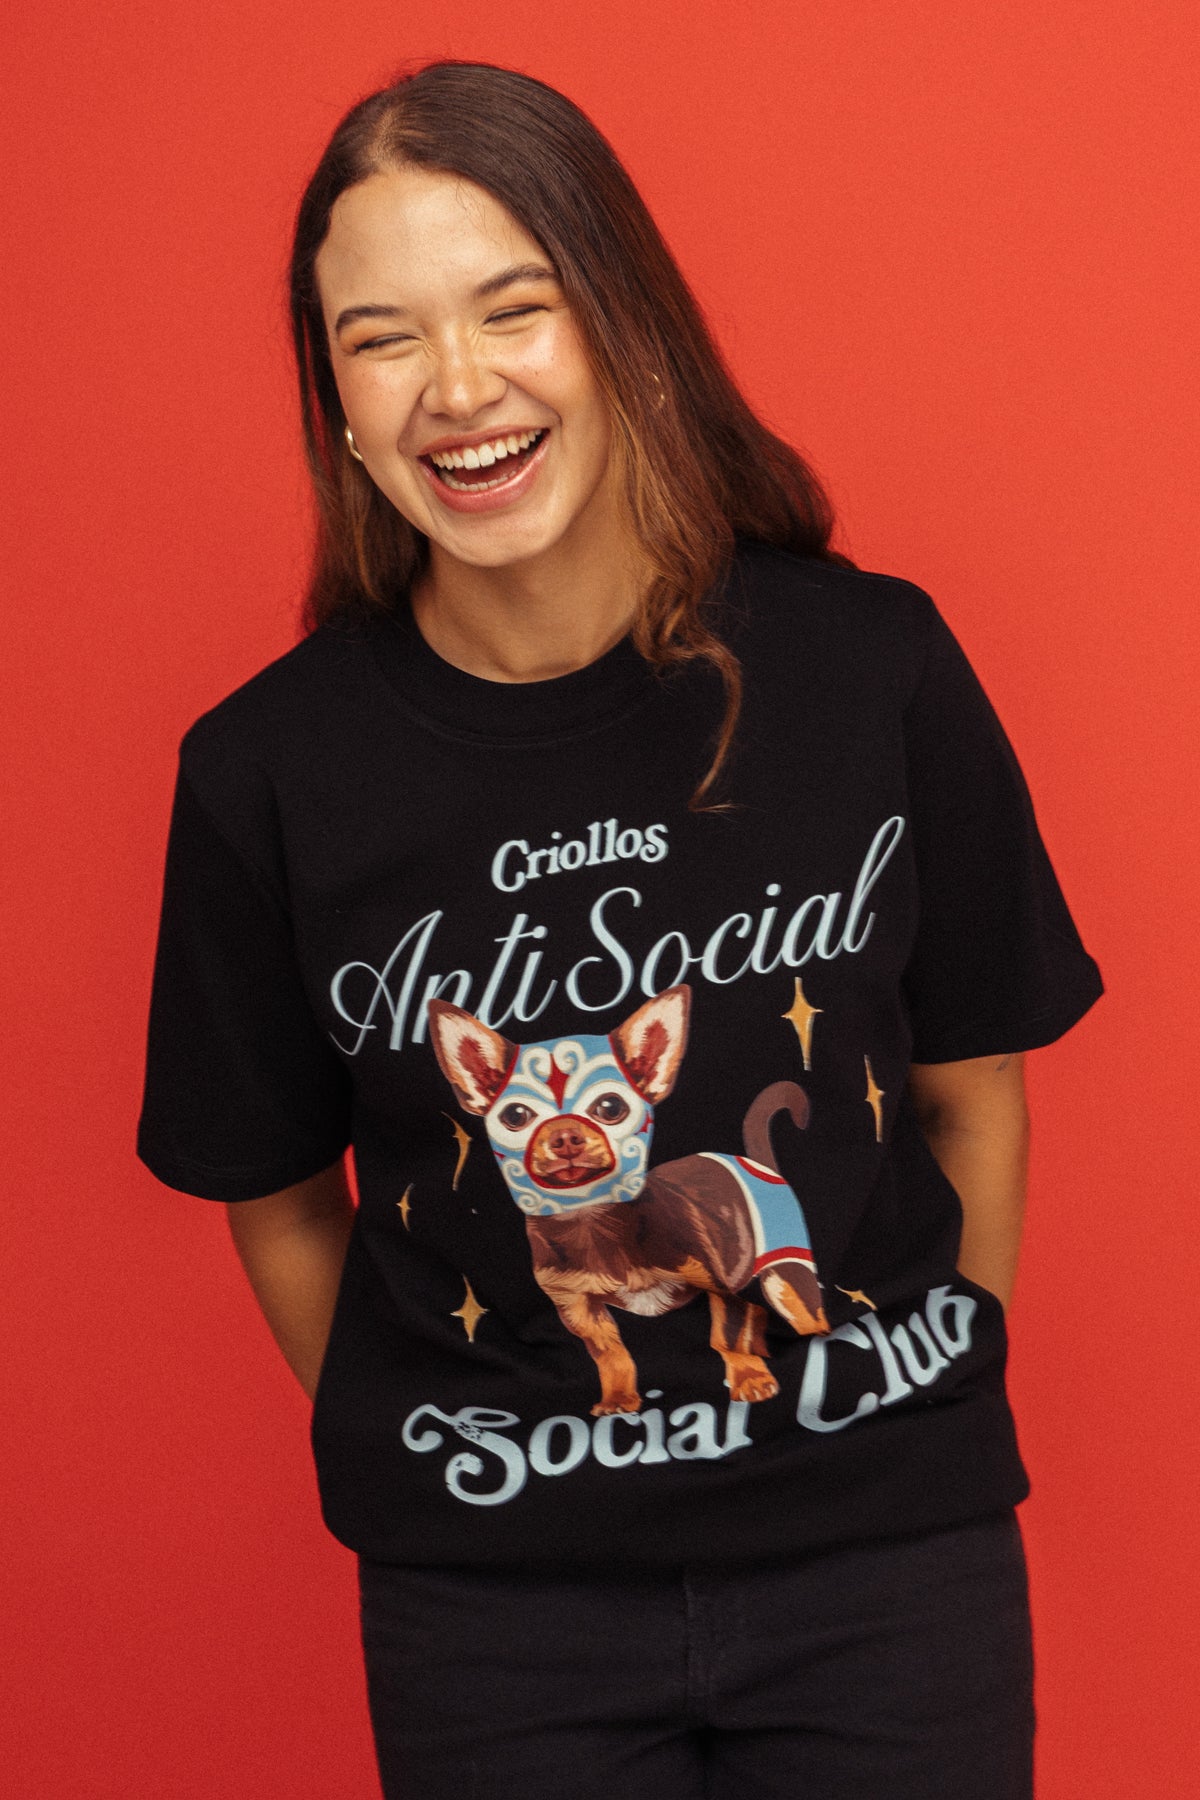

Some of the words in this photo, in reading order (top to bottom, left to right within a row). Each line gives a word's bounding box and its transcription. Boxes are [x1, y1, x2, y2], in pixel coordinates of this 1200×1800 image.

[329, 909, 557, 1056] Anti
[566, 815, 905, 1012] Social
[491, 817, 669, 893] Criollos
[401, 1379, 753, 1506] Social
[796, 1285, 977, 1433] Club
